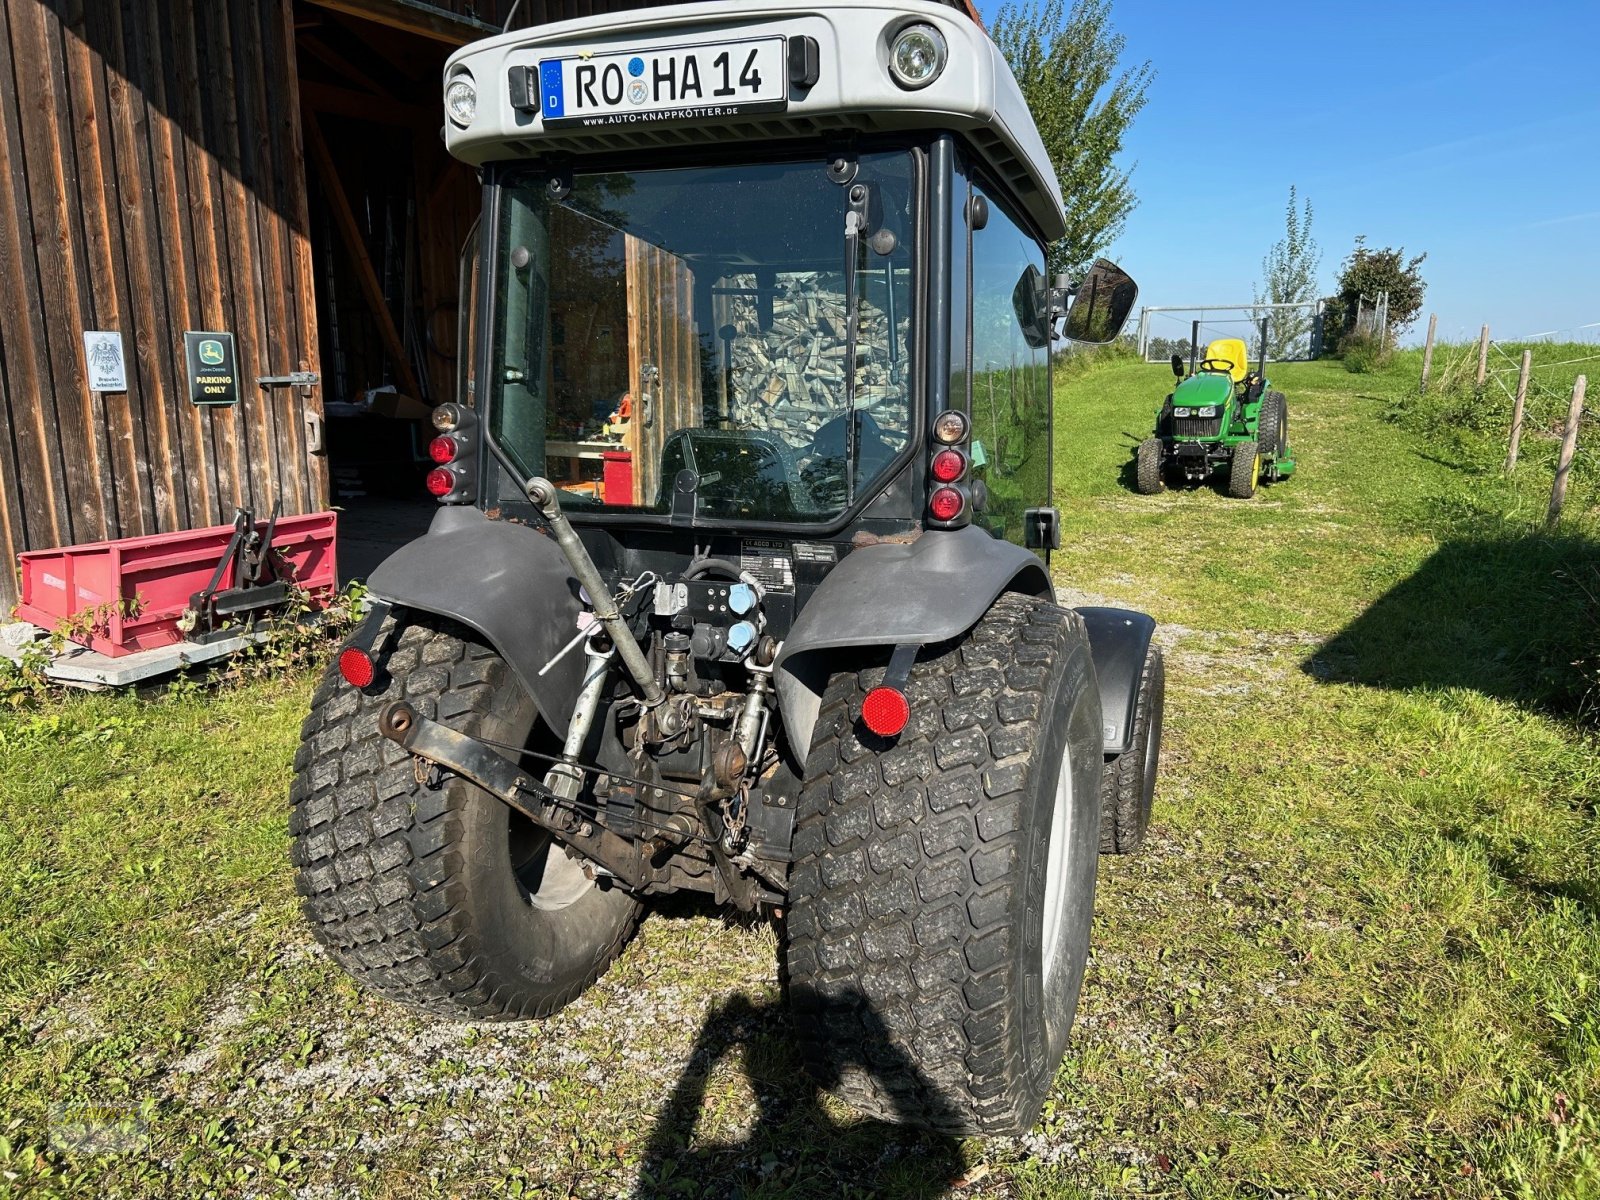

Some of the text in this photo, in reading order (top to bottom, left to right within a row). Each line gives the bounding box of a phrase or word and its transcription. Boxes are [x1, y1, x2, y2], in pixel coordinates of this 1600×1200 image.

[576, 63, 624, 108] RO
[652, 55, 702, 102] HA
[713, 48, 762, 97] 14
[549, 95, 558, 108] D
[196, 376, 232, 384] PARKING
[204, 386, 226, 394] ONLY
